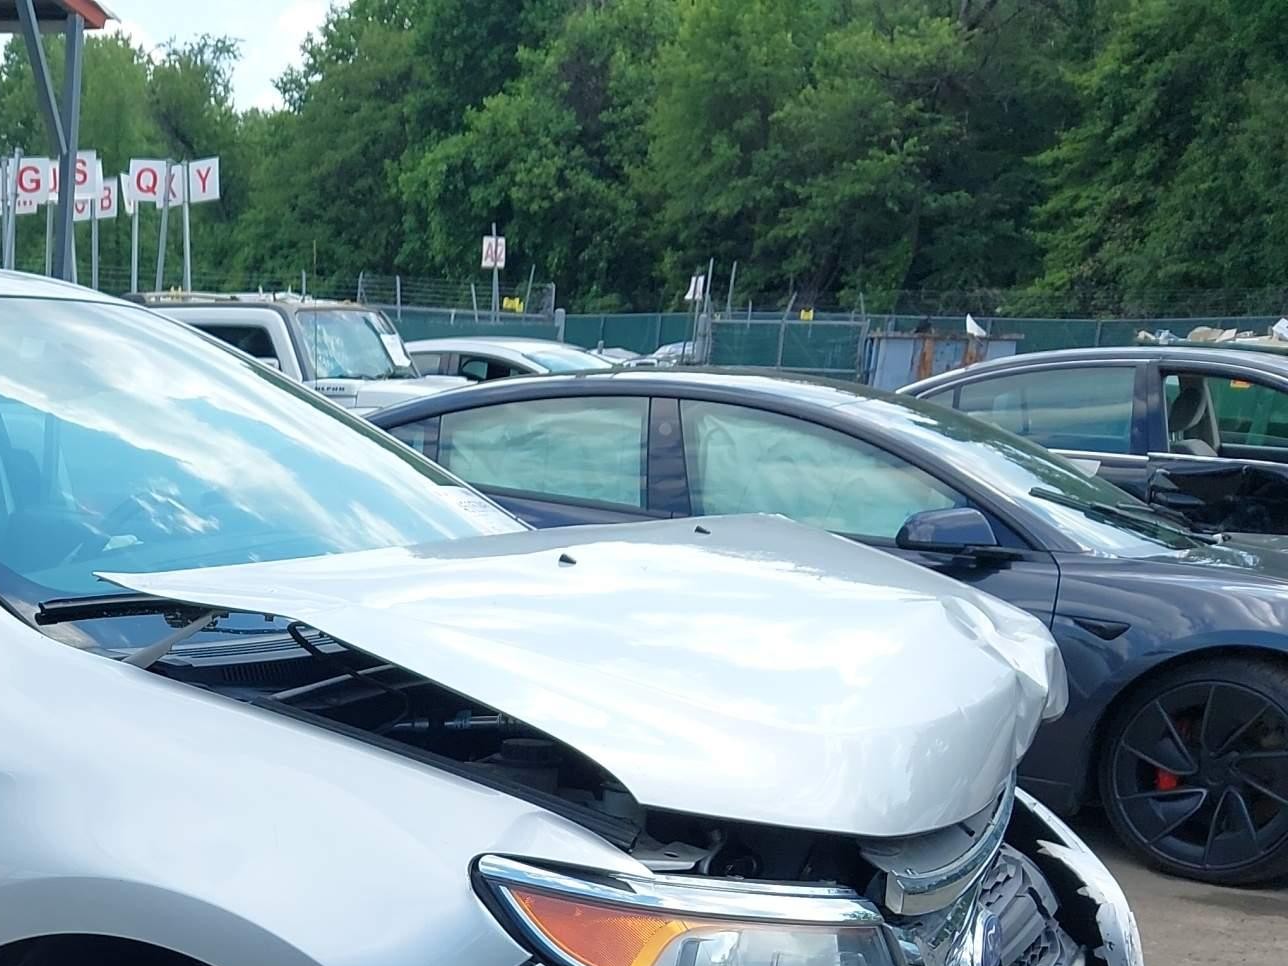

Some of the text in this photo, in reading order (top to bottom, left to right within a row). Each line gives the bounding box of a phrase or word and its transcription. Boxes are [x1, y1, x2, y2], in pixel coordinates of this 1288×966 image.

[18, 165, 41, 193] G
[136, 167, 158, 196] Q
[196, 166, 211, 193] Y
